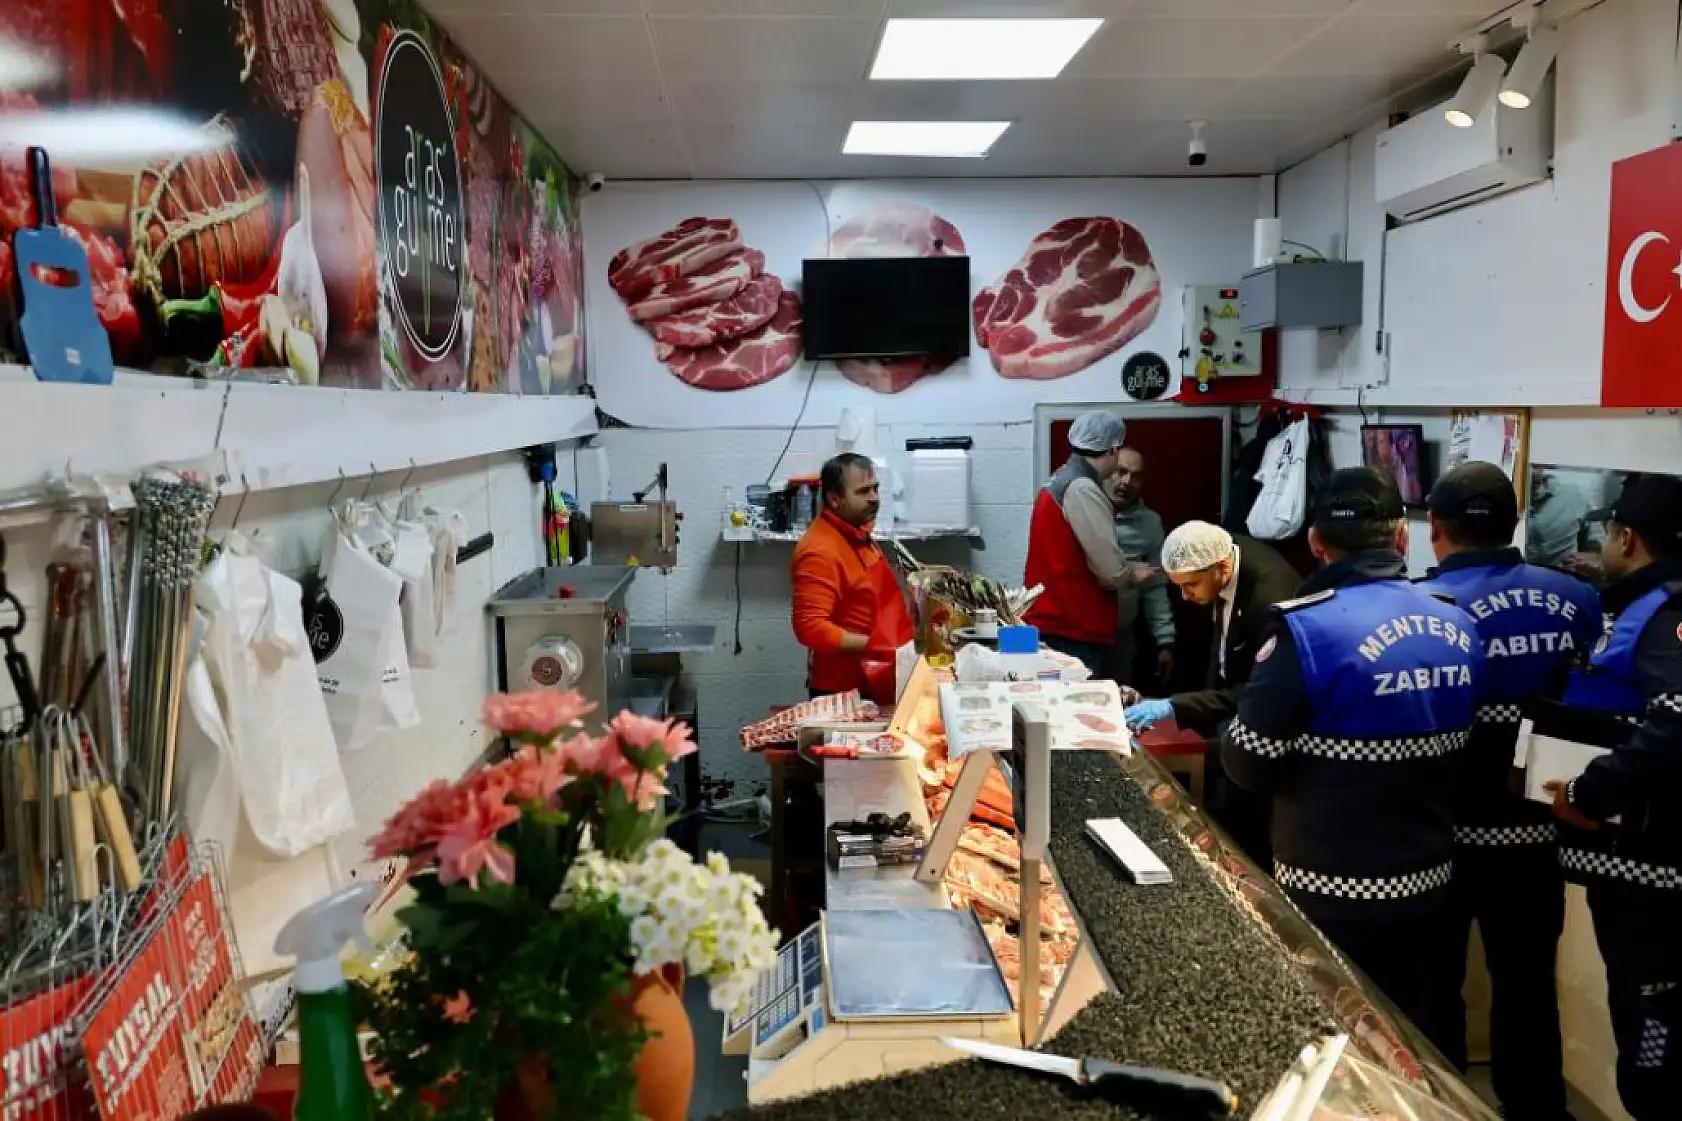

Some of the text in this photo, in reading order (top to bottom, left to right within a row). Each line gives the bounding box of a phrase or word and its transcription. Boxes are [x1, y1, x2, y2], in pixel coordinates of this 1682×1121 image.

[1468, 587, 1578, 622] ENTEŞE
[1357, 614, 1472, 662] MENTEŞE
[1480, 630, 1576, 658] ABITA
[1373, 664, 1472, 697] ZABITA
